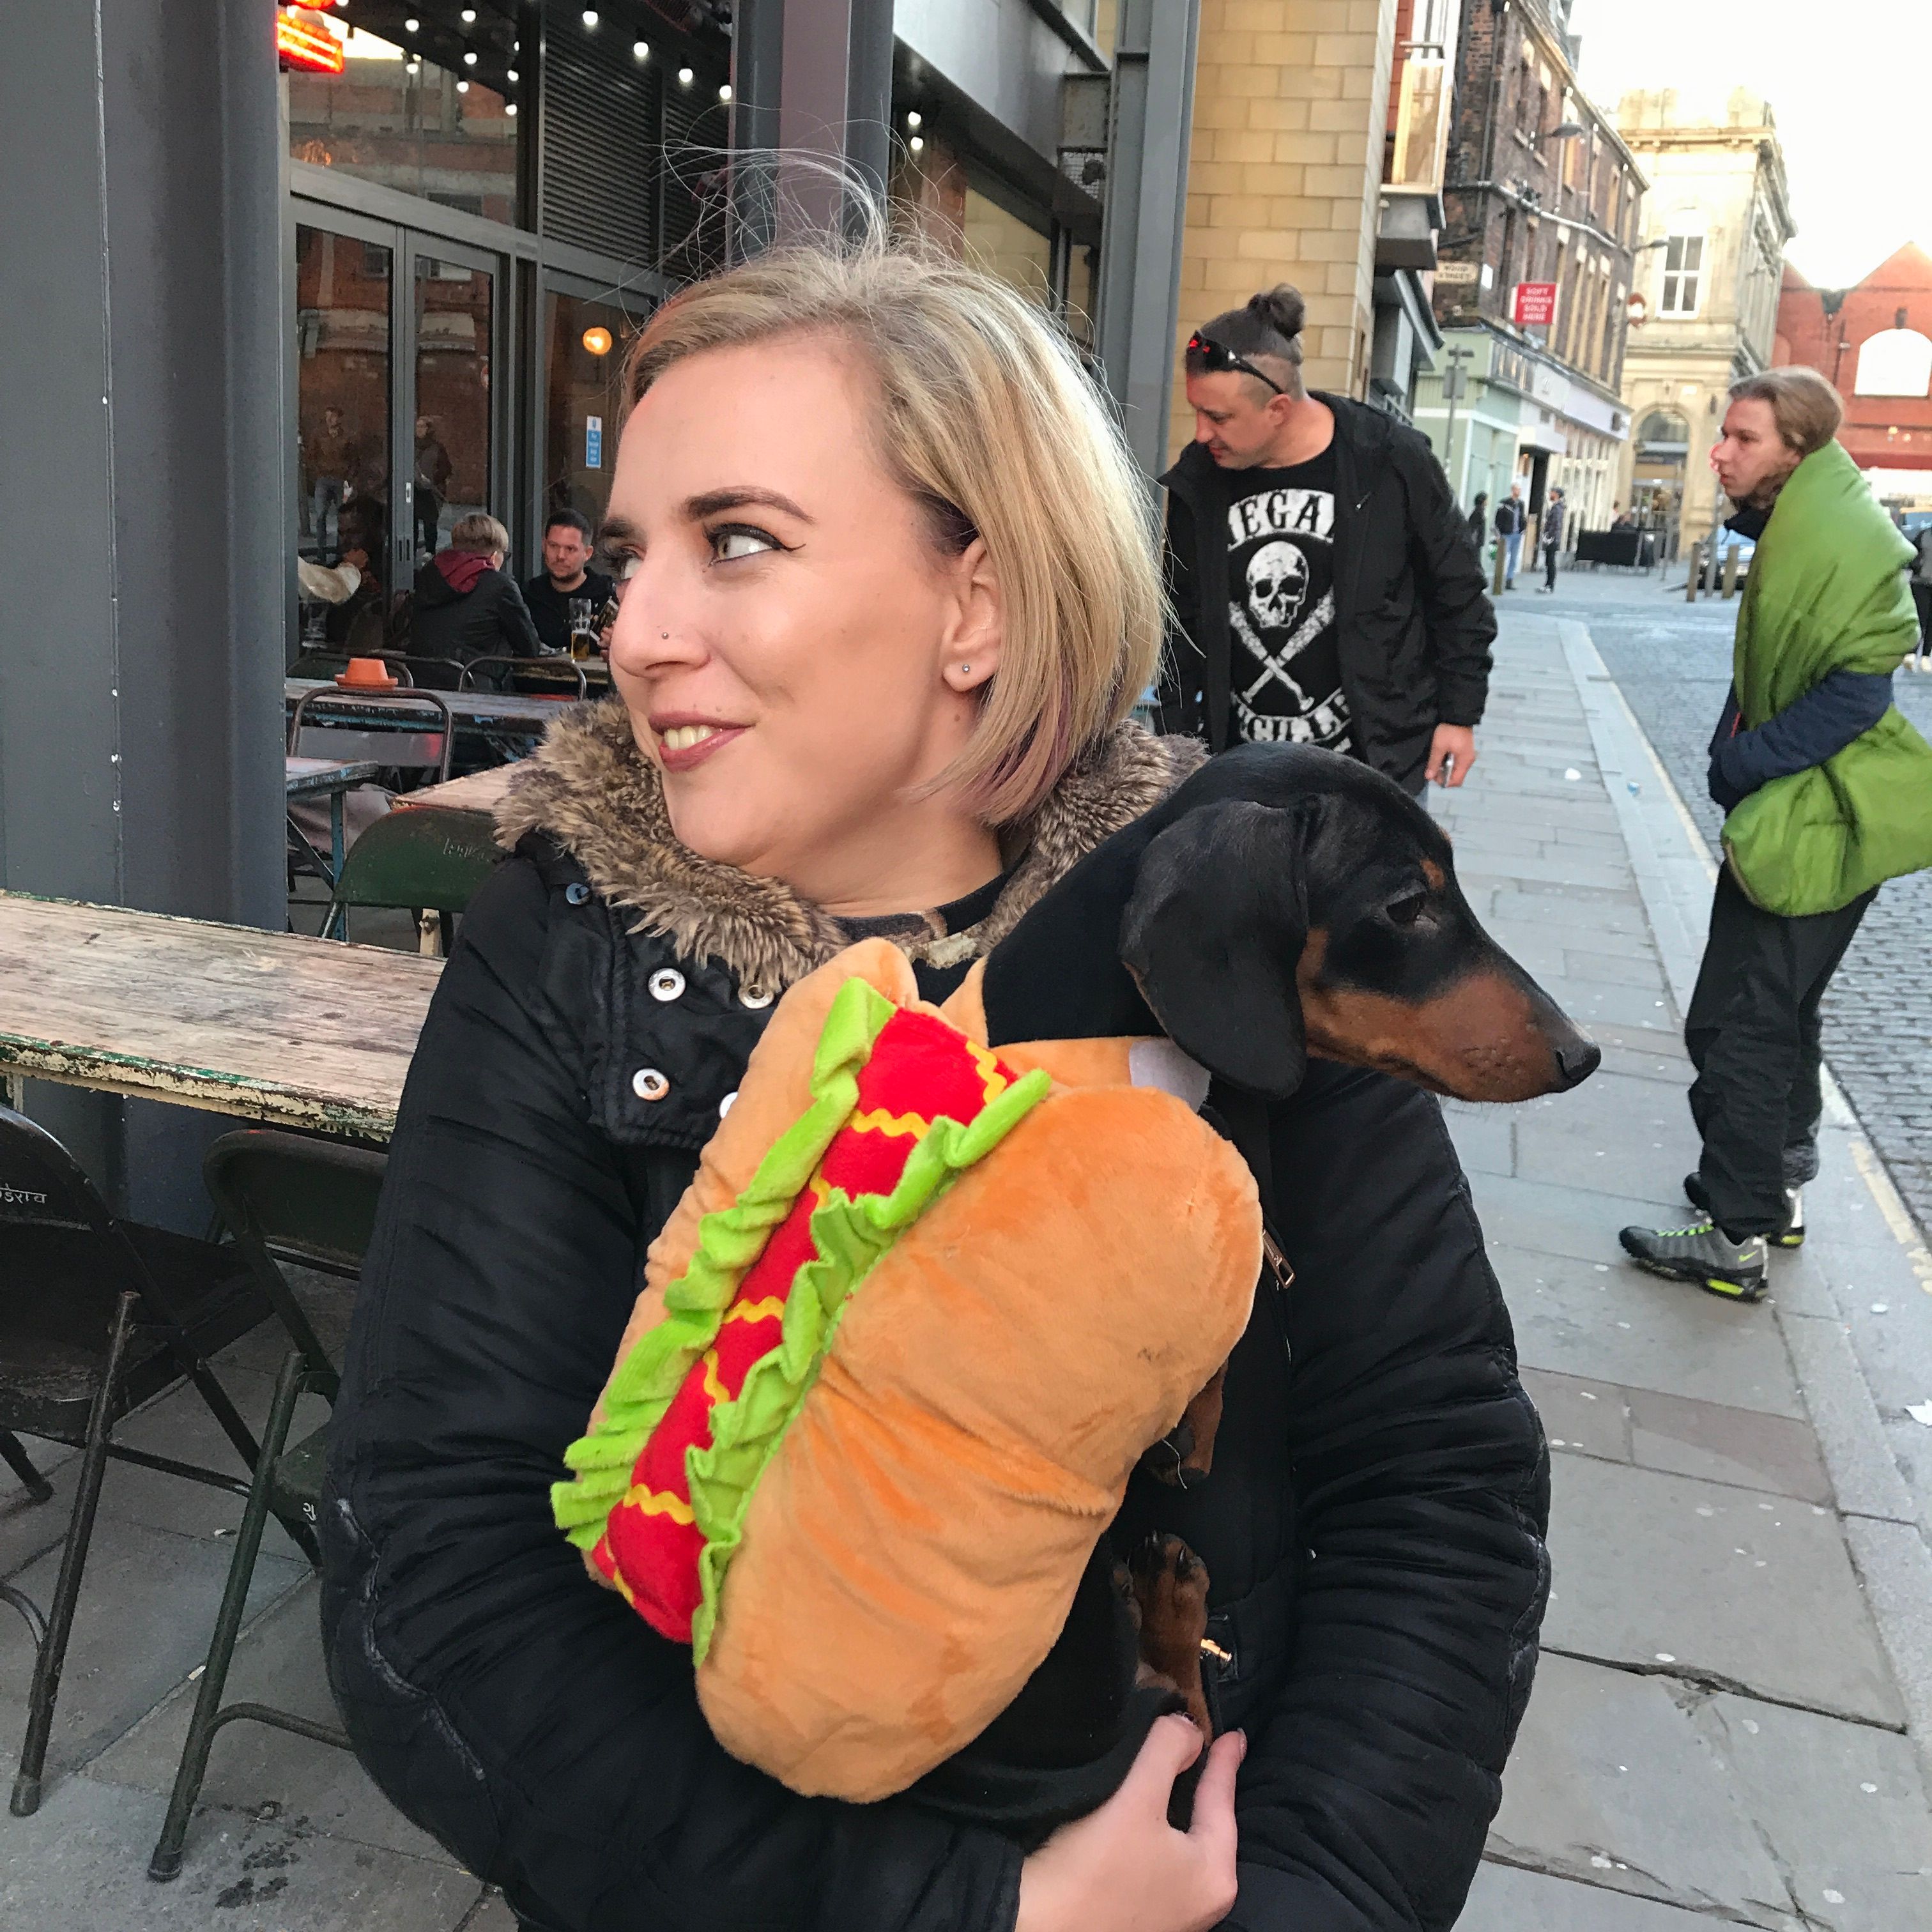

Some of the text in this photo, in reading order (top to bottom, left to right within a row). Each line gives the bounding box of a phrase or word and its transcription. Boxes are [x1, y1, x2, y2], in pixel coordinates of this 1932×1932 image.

[1526, 287, 1549, 295] SOFT
[1523, 304, 1547, 312] SOLD
[1228, 489, 1335, 544] EGA
